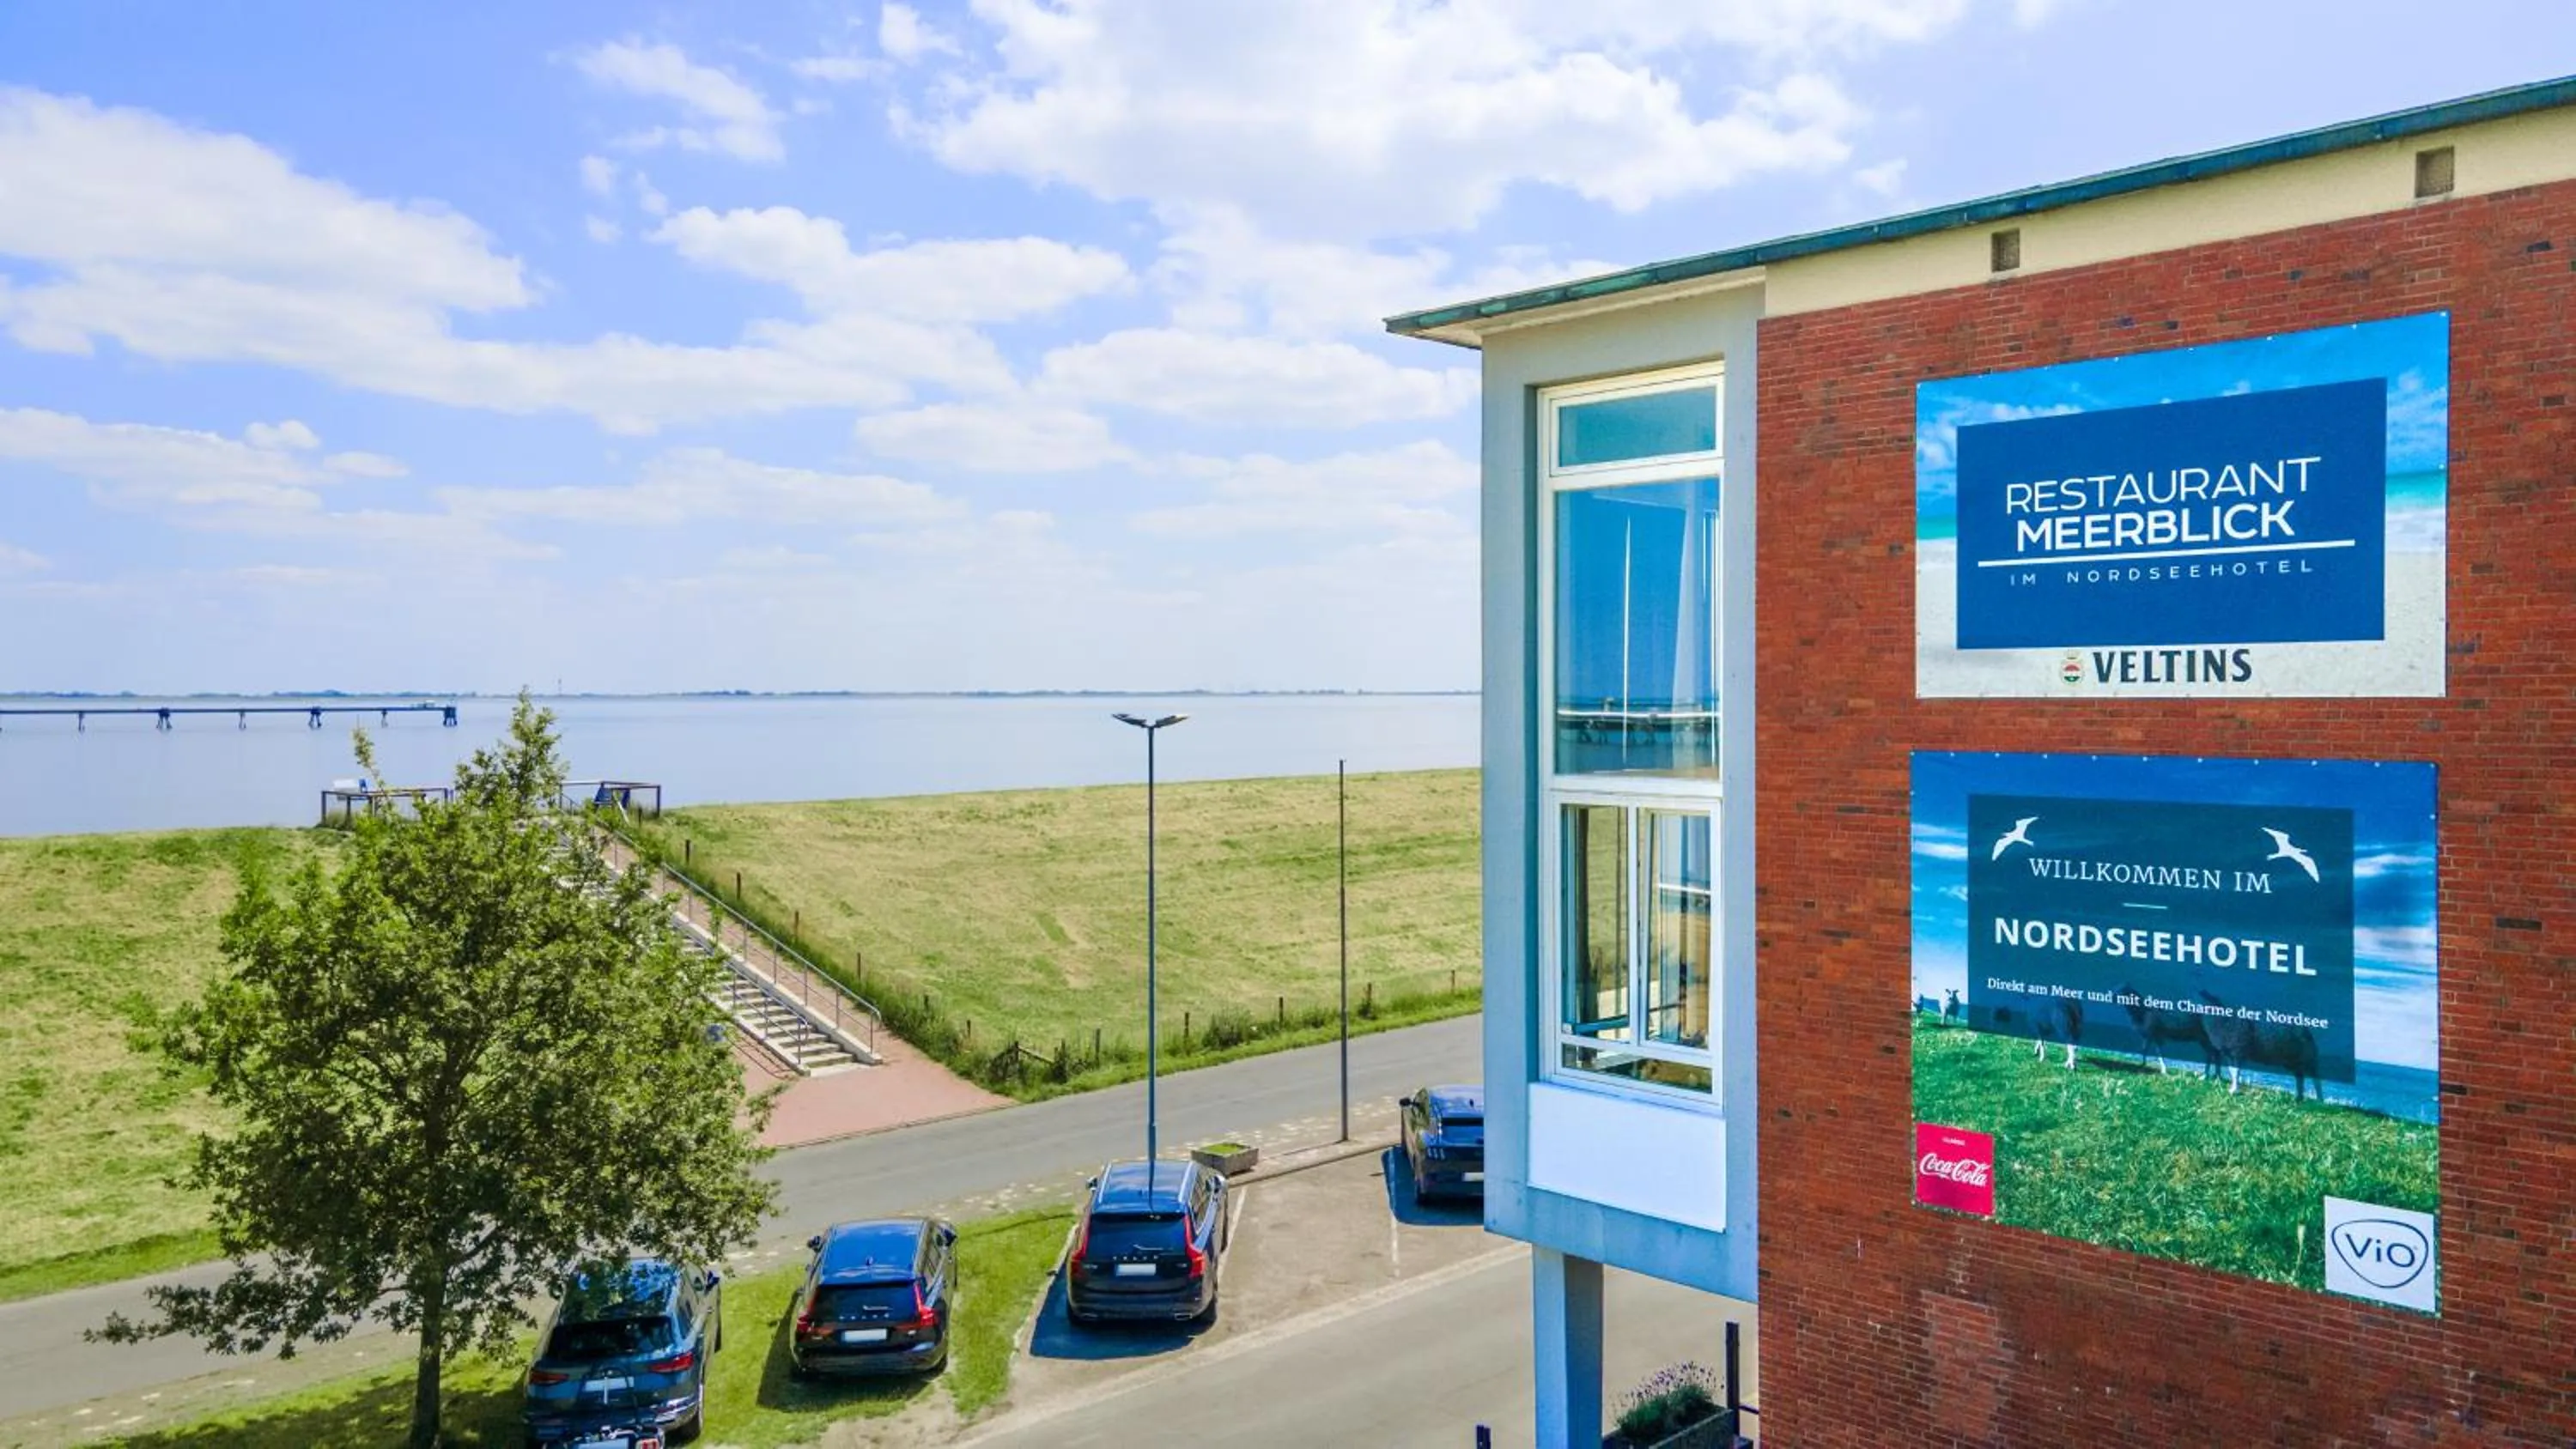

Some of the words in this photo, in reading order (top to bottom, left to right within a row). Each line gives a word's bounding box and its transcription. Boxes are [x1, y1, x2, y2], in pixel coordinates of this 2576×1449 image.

[2006, 456, 2321, 514] RESTAURANT
[2017, 500, 2295, 551] MEERBLICK
[2010, 573, 2037, 585] IM
[2067, 559, 2313, 584] NORDSEEHOTEL
[2093, 648, 2253, 683] VELTINS
[2029, 858, 2221, 890] WILLKOMMEN
[2233, 870, 2272, 894] IM
[1994, 918, 2317, 976] NORDSEEHOTEL
[1987, 977, 2025, 993] Direkt
[2027, 984, 2048, 995] am
[2050, 985, 2084, 1000] Meer
[2087, 991, 2113, 1003] und
[2117, 993, 2140, 1007] mit
[2143, 995, 2173, 1010] dem
[2177, 999, 2233, 1018] Charme
[2237, 1006, 2263, 1022] der
[2265, 1009, 2329, 1029] Nordsee
[1919, 1152, 1991, 1187] Coca-Cola
